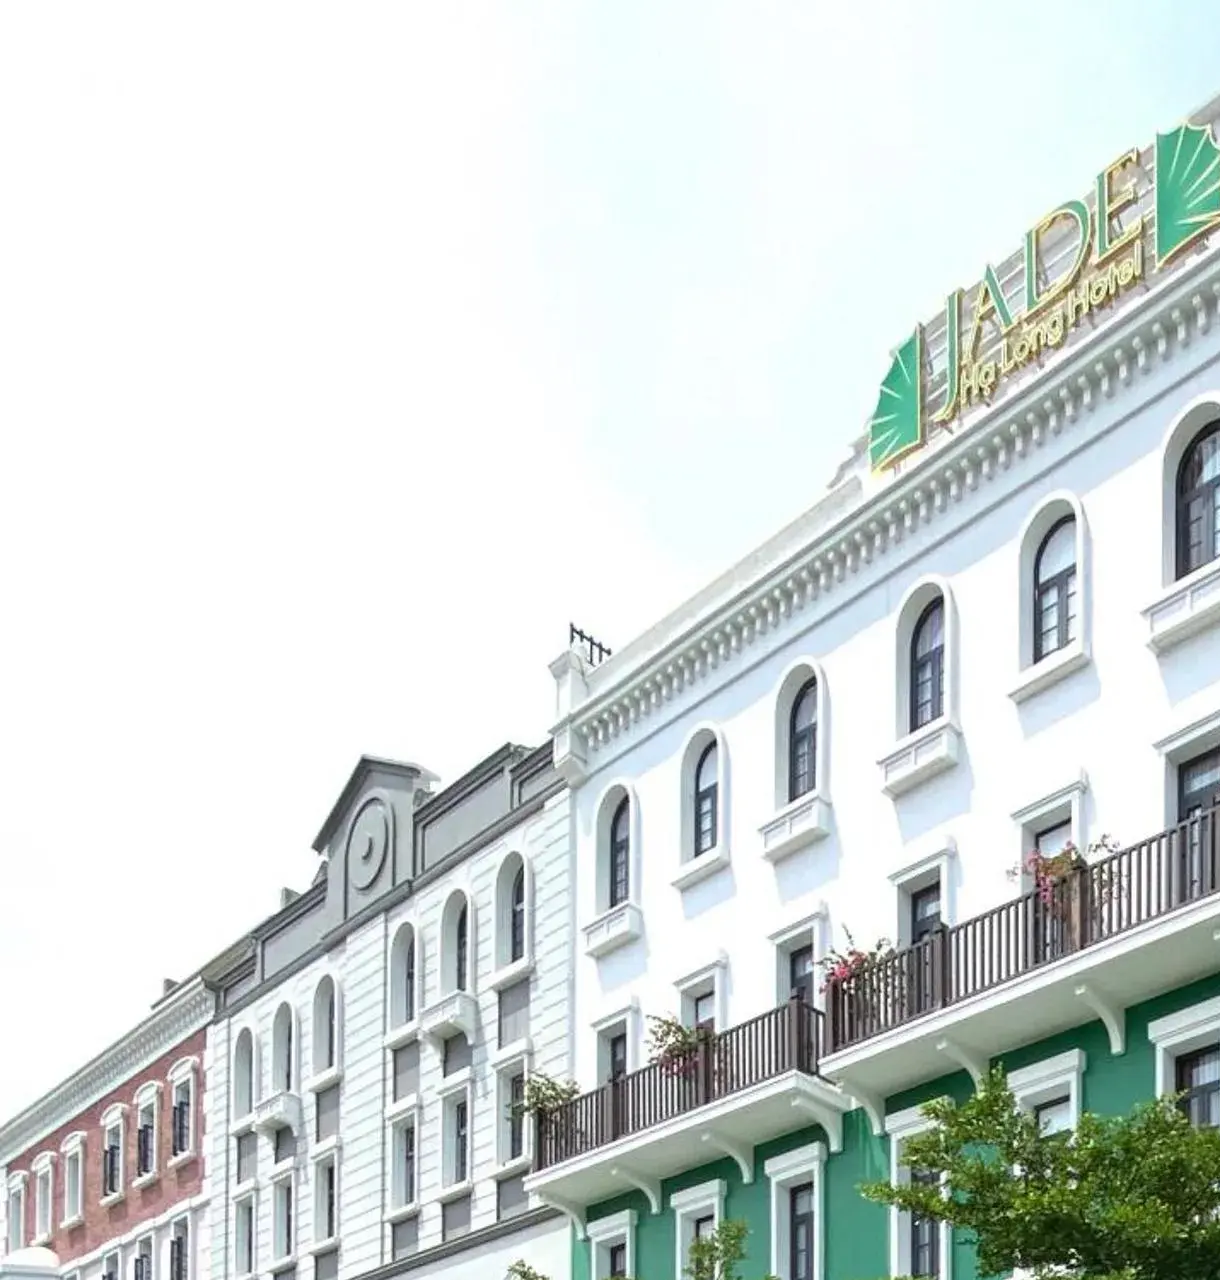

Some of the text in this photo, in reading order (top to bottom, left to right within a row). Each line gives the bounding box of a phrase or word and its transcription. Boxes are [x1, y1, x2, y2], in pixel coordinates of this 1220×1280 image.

[931, 147, 1142, 422] JADE
[1001, 307, 1065, 374] Long
[1067, 240, 1143, 328] Hotel
